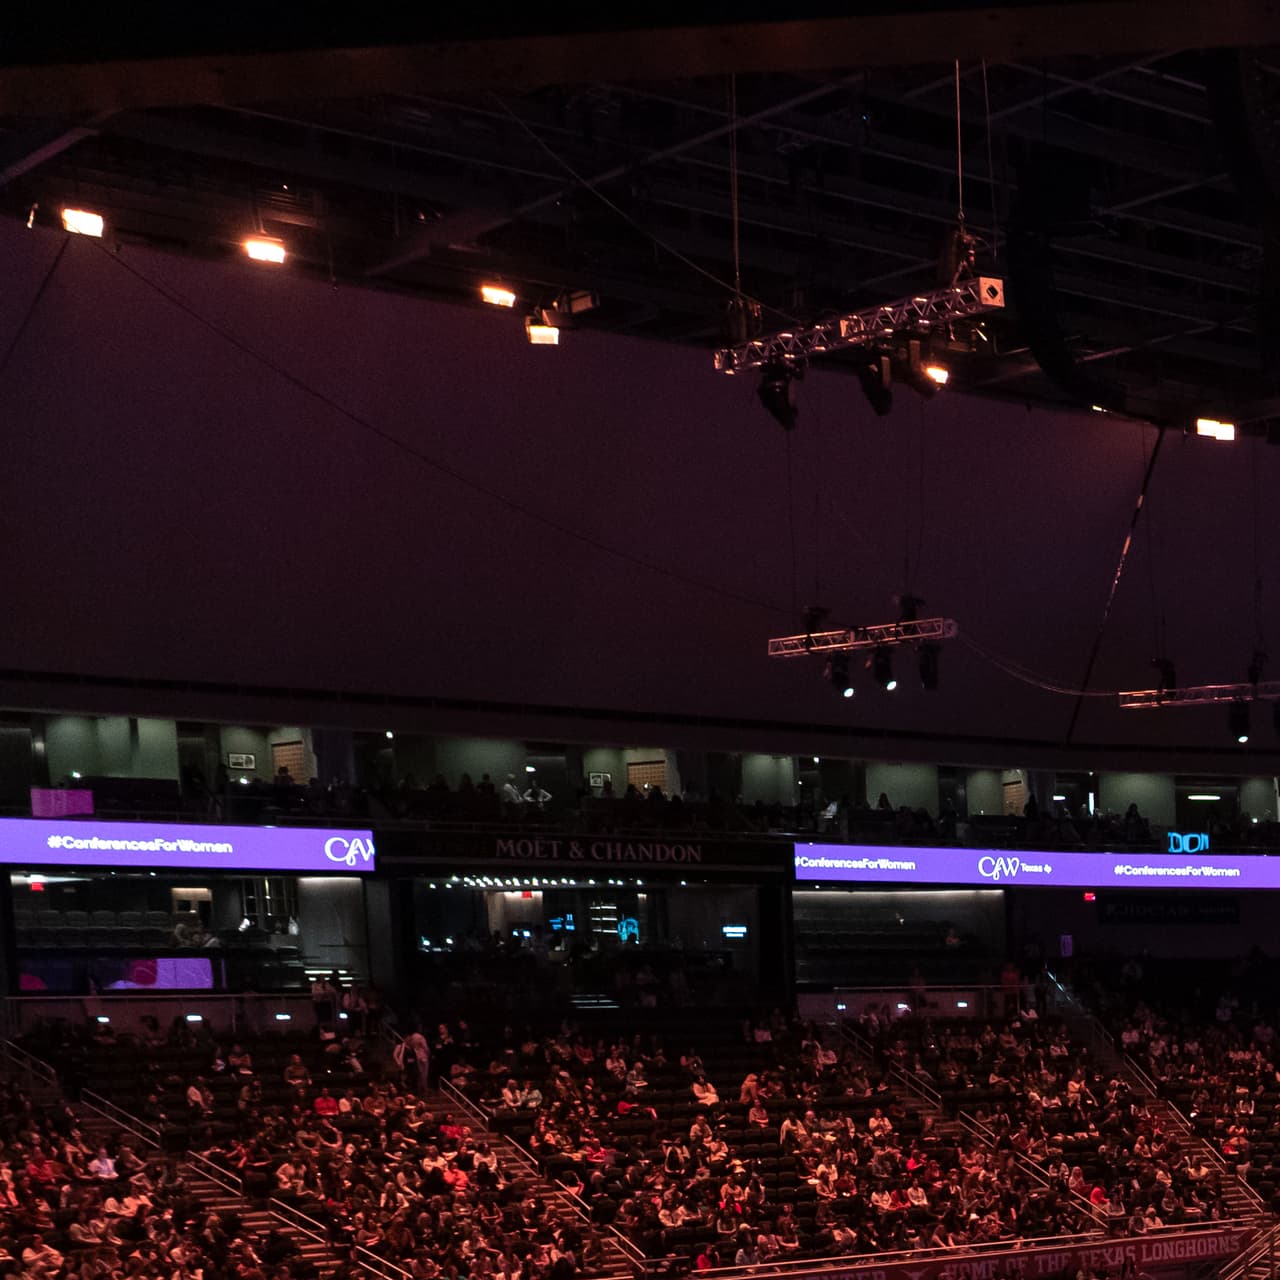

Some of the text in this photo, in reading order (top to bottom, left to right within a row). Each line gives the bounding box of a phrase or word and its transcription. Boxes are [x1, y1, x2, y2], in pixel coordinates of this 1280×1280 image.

[46, 834, 234, 854] #ConferencesForWomen
[568, 841, 584, 859] &
[591, 842, 703, 864] CHANDON
[1114, 865, 1240, 877] #ConferencesForWomen
[1077, 1247, 1137, 1268] TEXAS
[1141, 1235, 1241, 1263] LONGHORNS
